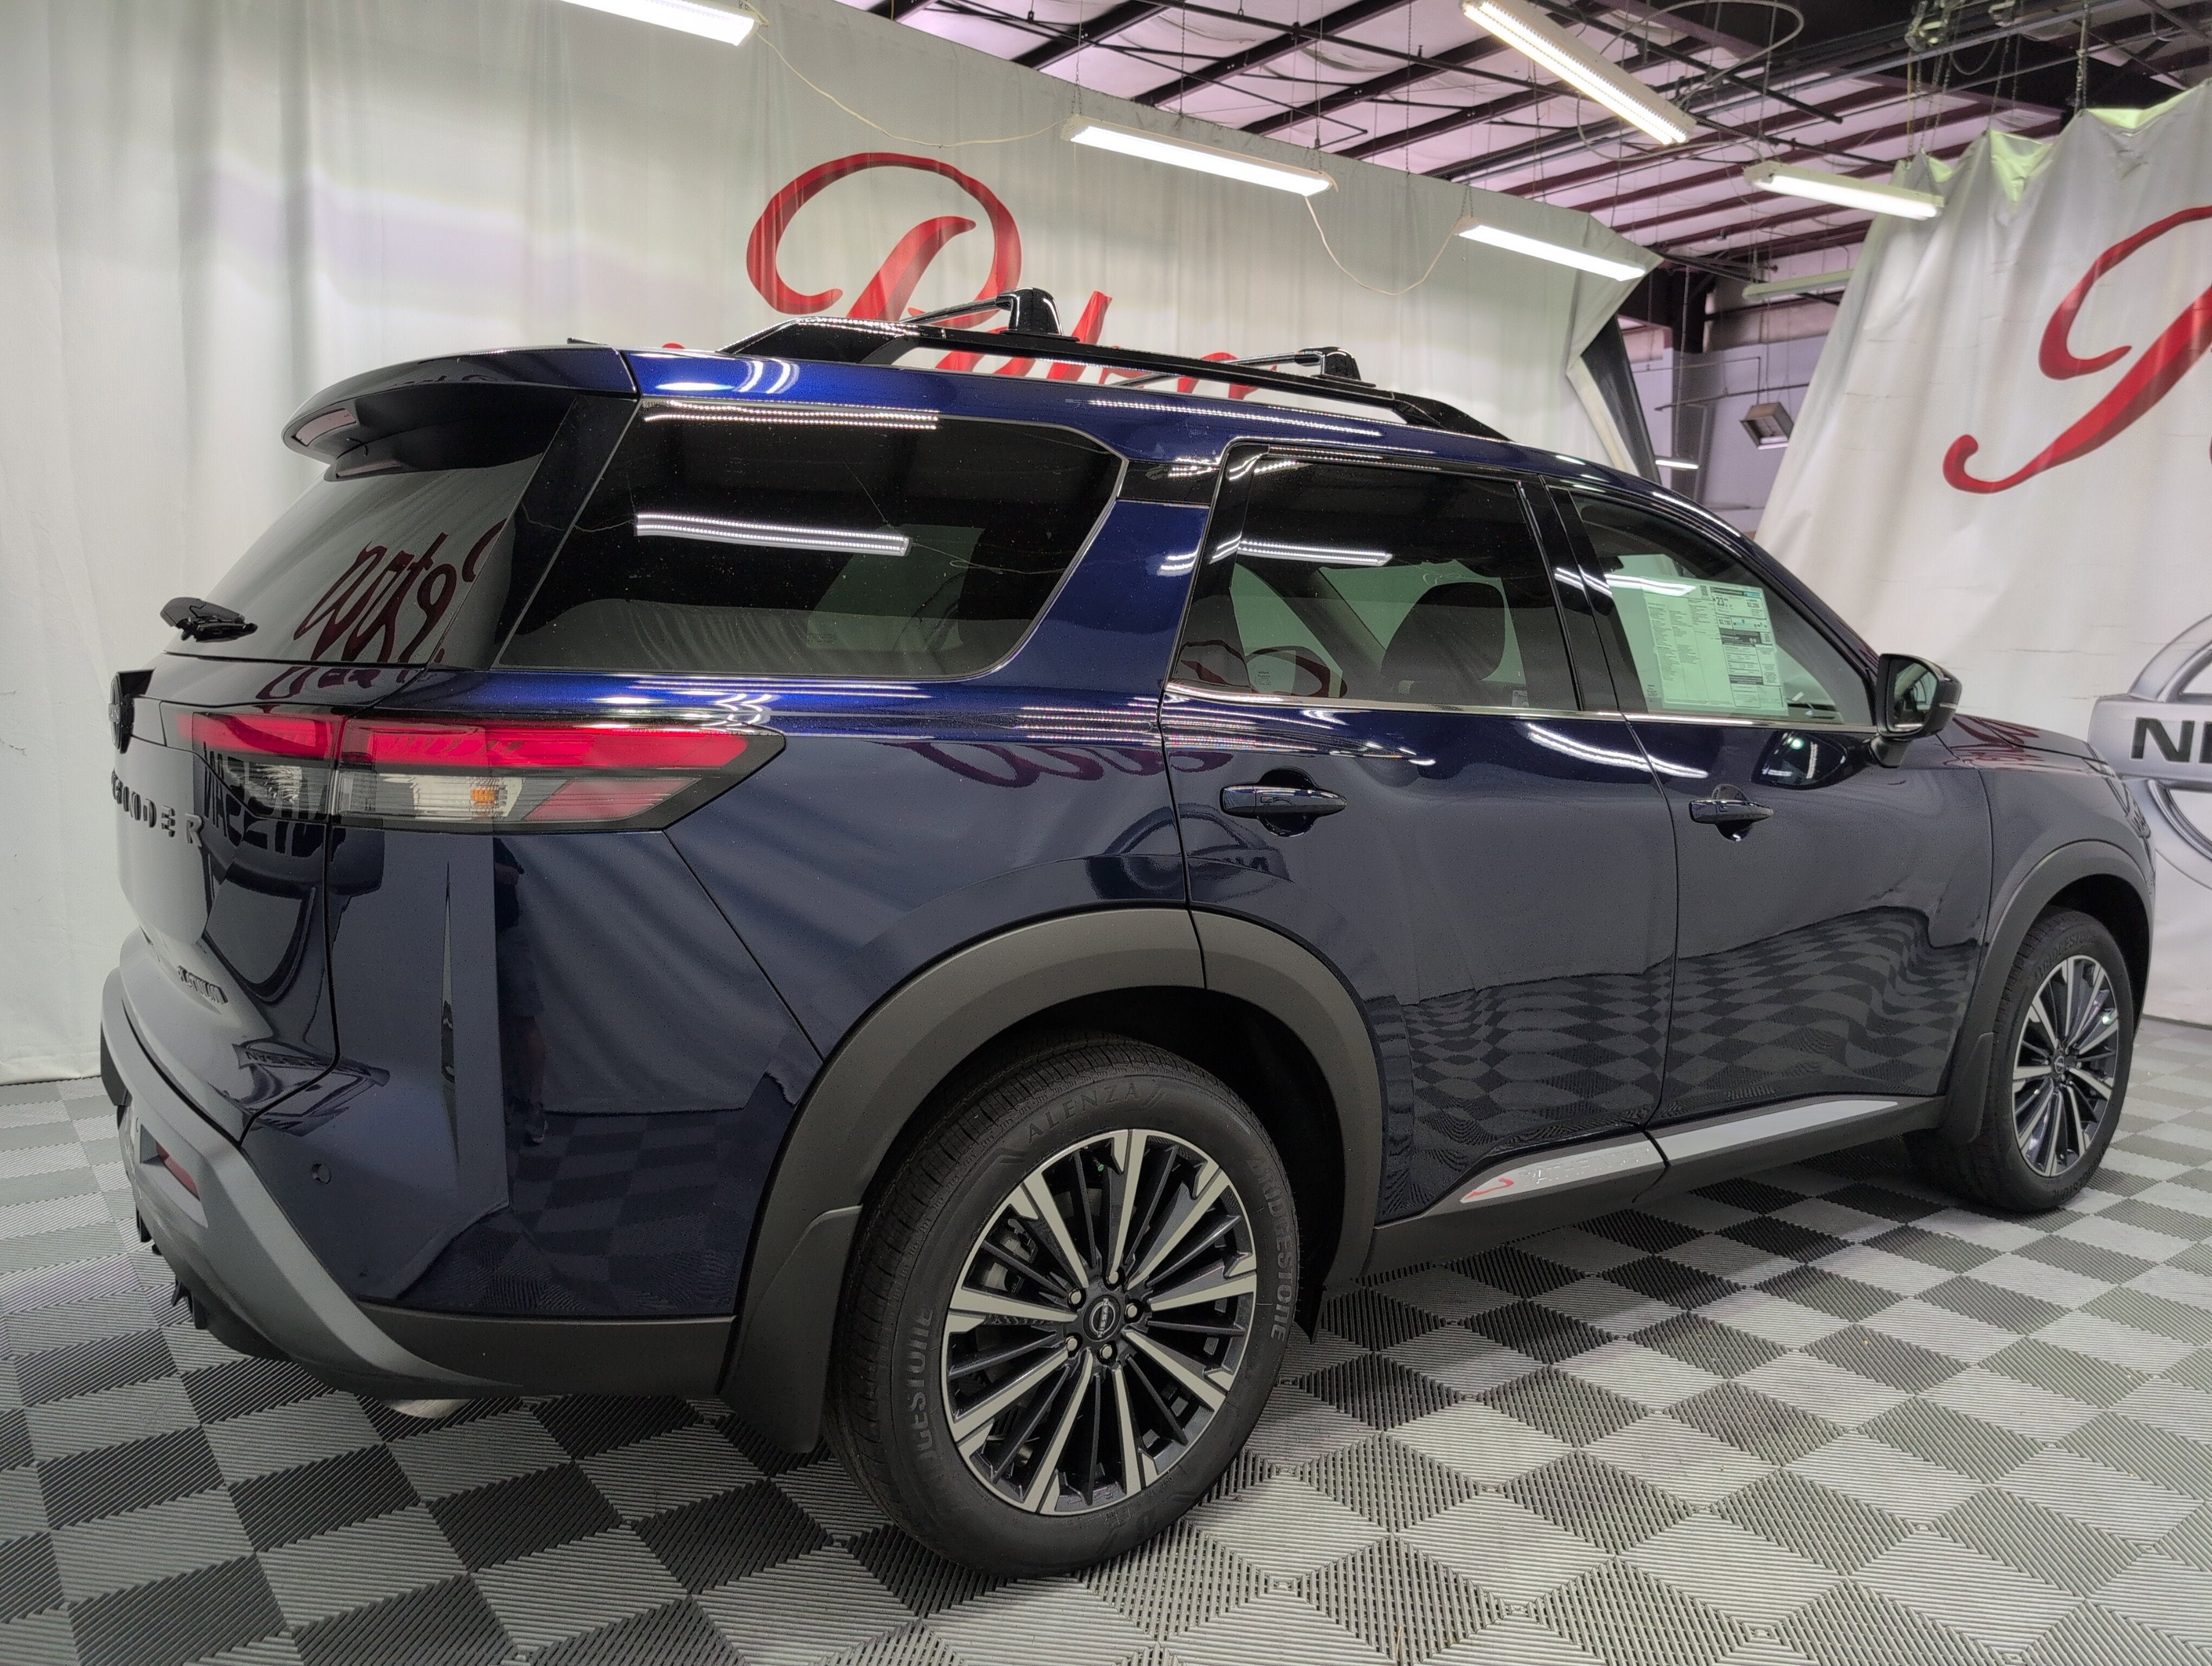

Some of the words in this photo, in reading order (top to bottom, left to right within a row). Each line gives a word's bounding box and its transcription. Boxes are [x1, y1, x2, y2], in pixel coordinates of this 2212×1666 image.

[1028, 1082, 1140, 1144] ALENZA
[1247, 1157, 1295, 1343] BRIDGESTONE
[1096, 1297, 1110, 1339] NISSAN
